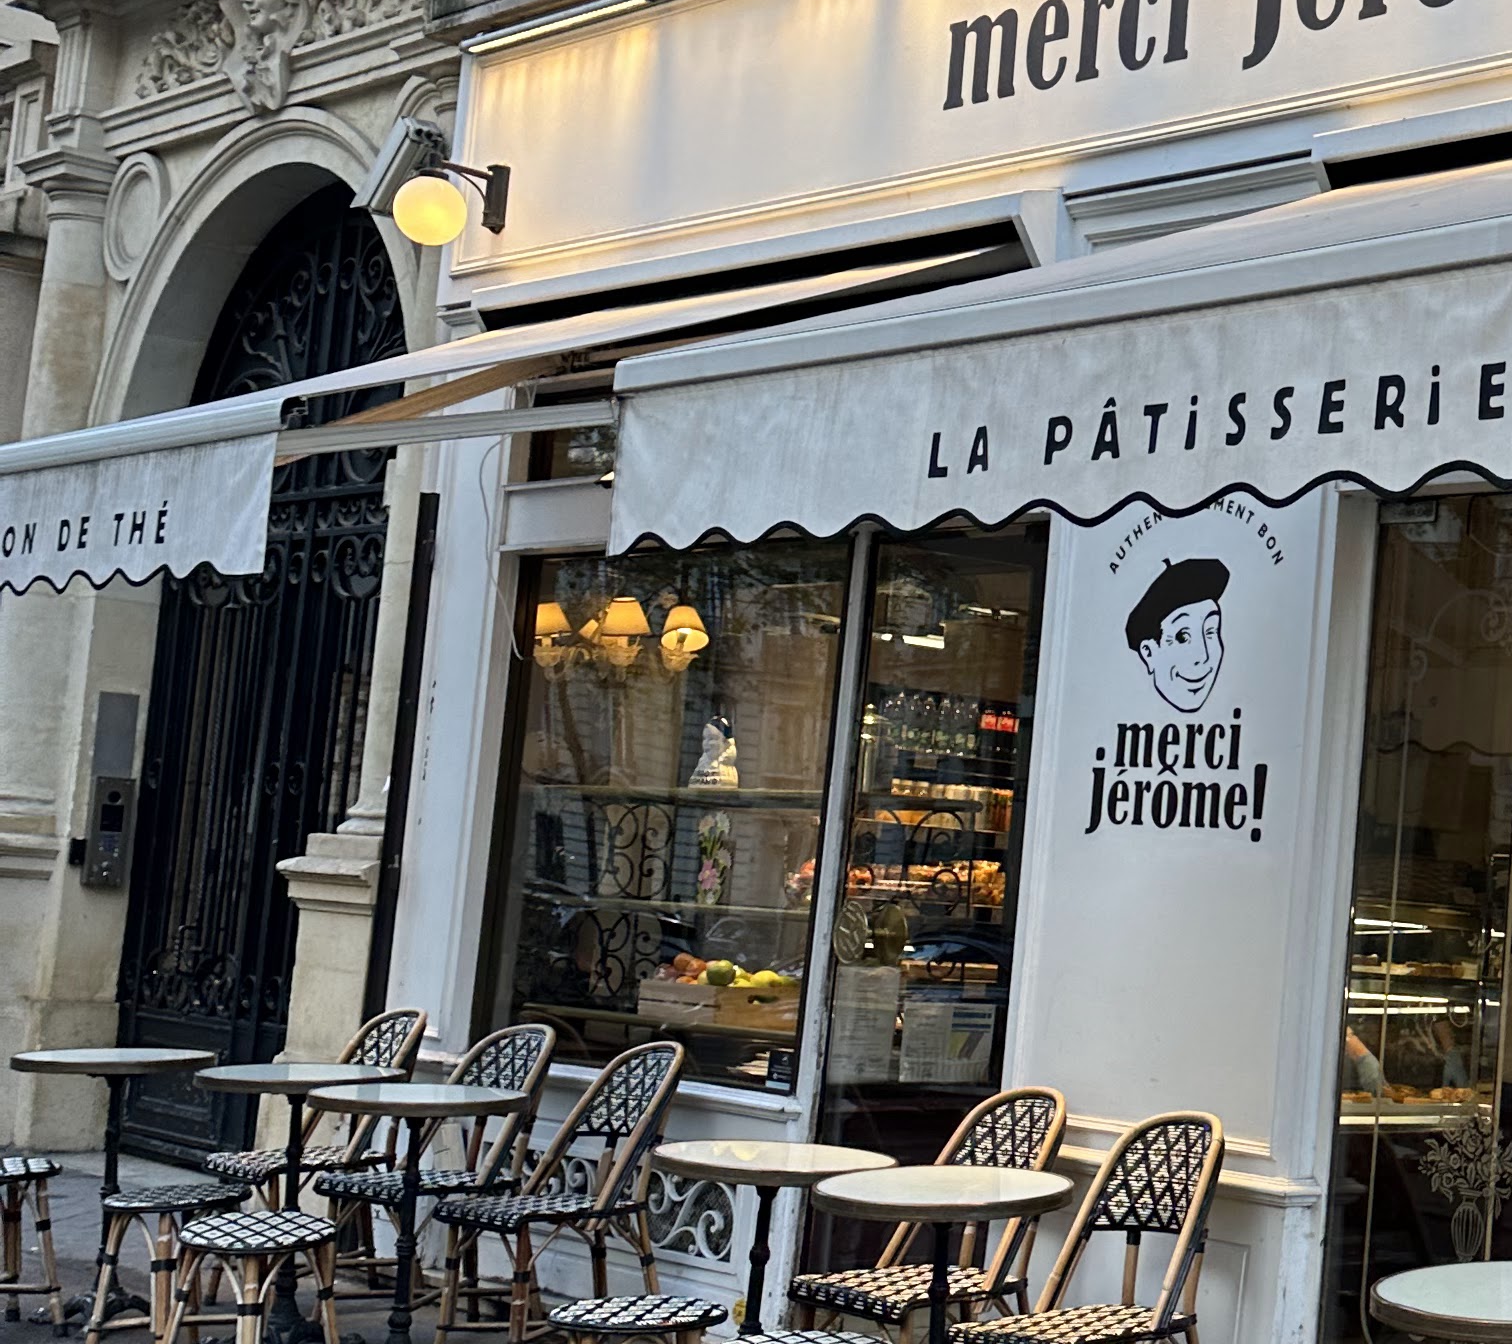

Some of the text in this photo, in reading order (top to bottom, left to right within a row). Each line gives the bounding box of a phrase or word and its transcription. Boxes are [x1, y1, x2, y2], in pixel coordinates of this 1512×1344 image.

[927, 424, 990, 479] LA
[57, 515, 91, 552] DE
[113, 500, 169, 547] THÉ
[1257, 522, 1285, 567] BON
[1113, 706, 1243, 771] merci
[1084, 745, 1269, 843] jérôme!
